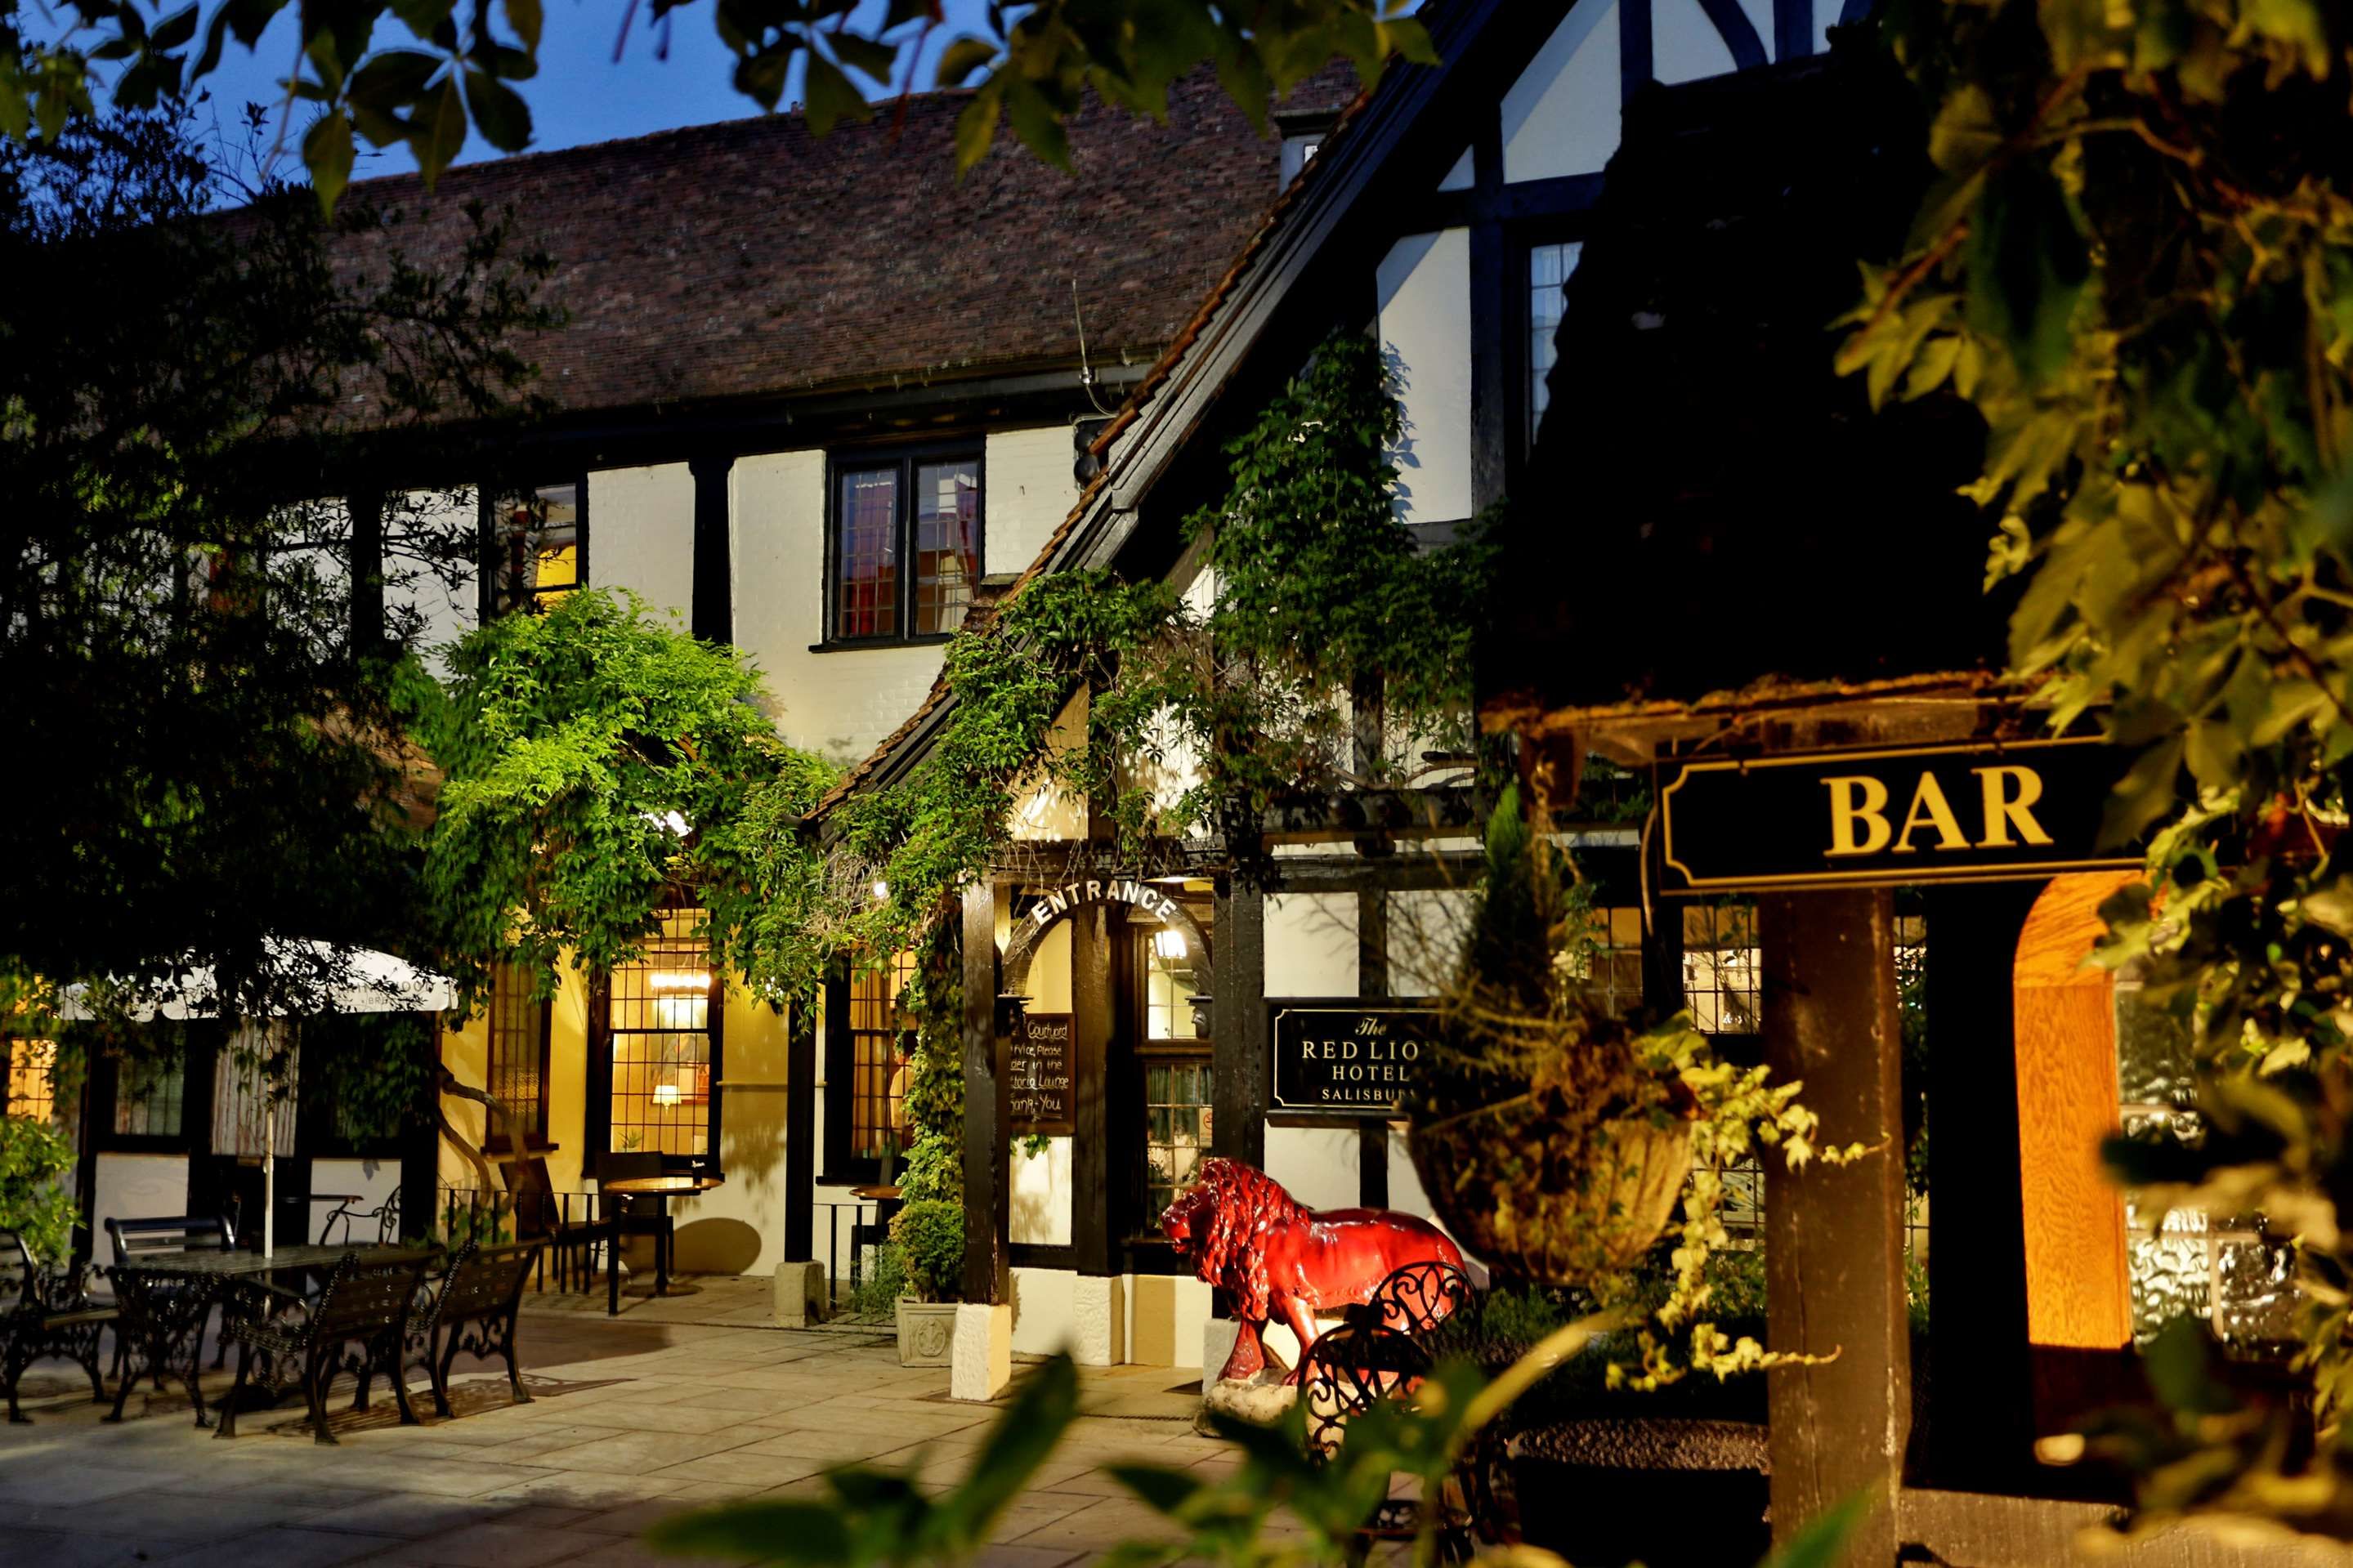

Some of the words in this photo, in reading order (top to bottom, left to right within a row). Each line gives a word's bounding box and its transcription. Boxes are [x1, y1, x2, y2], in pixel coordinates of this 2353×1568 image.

[1820, 766, 2054, 856] BAR
[1031, 879, 1177, 925] ENTRANCE
[1355, 1016, 1387, 1036] The
[1302, 1040, 1358, 1059] RED
[1370, 1040, 1429, 1061] LIO
[1332, 1065, 1411, 1082] HOTEL
